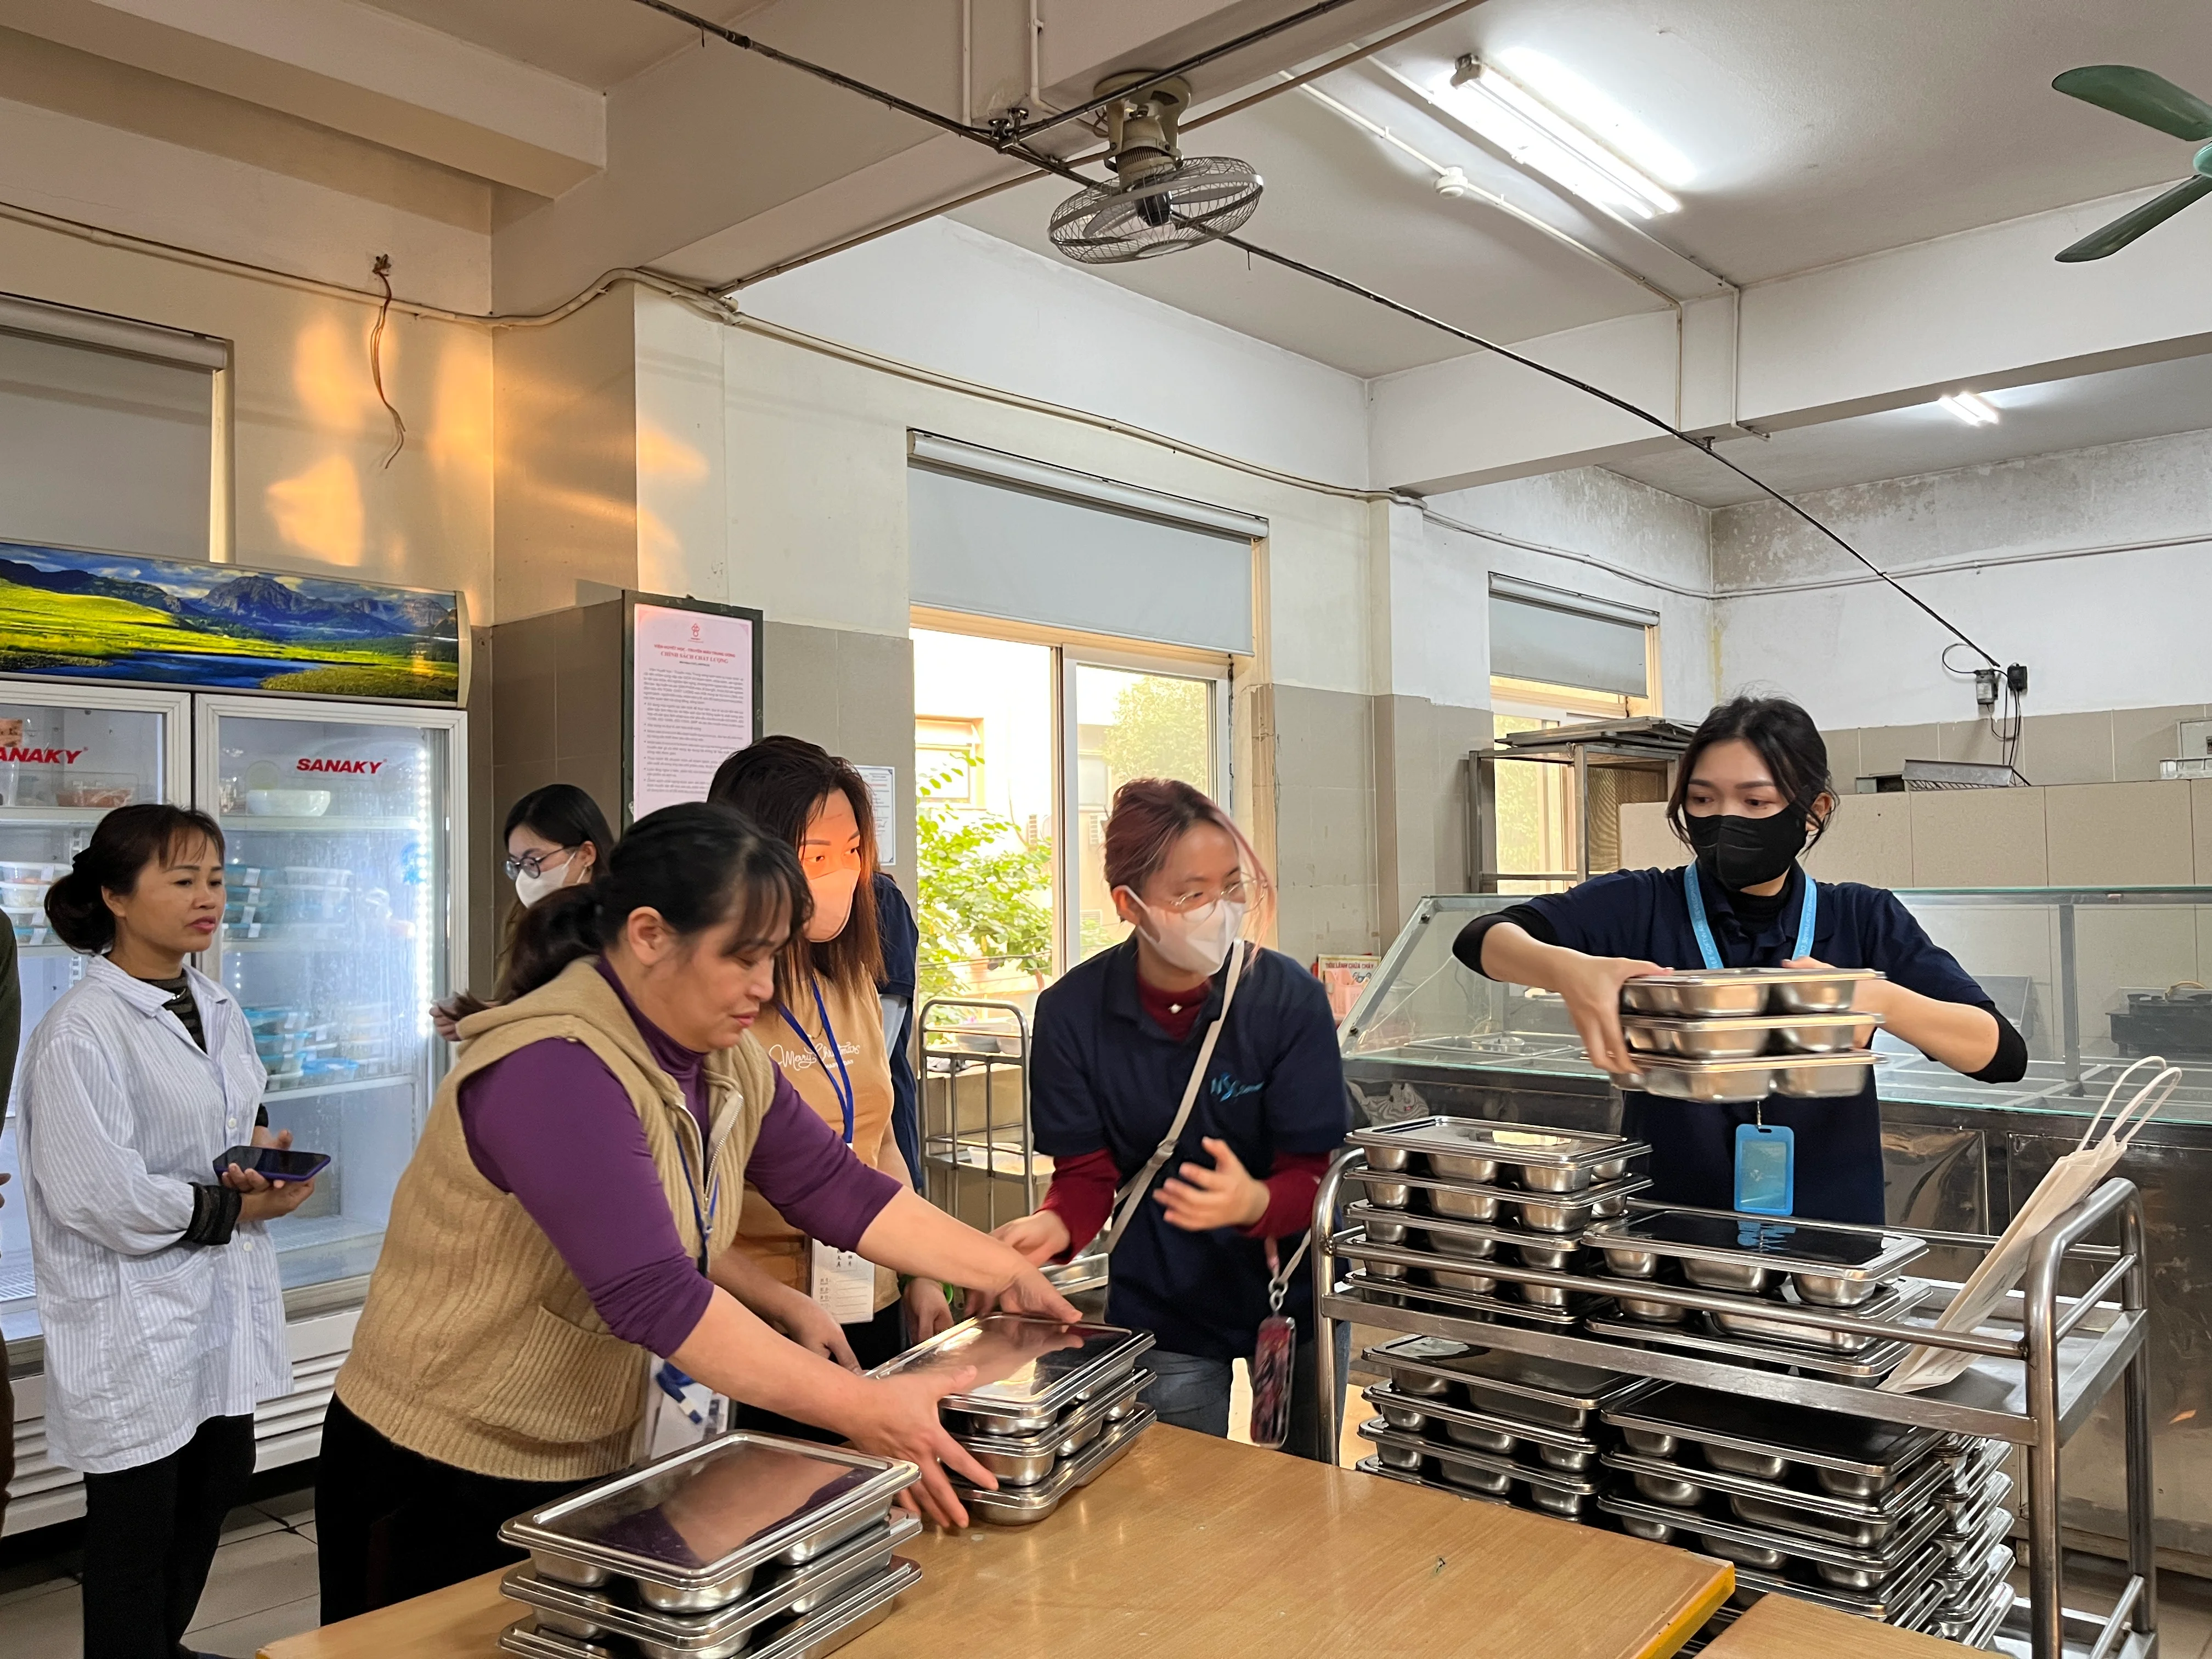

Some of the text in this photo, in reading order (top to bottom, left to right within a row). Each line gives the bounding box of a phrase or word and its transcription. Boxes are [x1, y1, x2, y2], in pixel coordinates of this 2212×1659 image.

[0, 747, 82, 764] ANAKY
[296, 758, 383, 774] SANAKY
[1696, 919, 1714, 955] SOFTWARE
[804, 1042, 860, 1062] Chritmas
